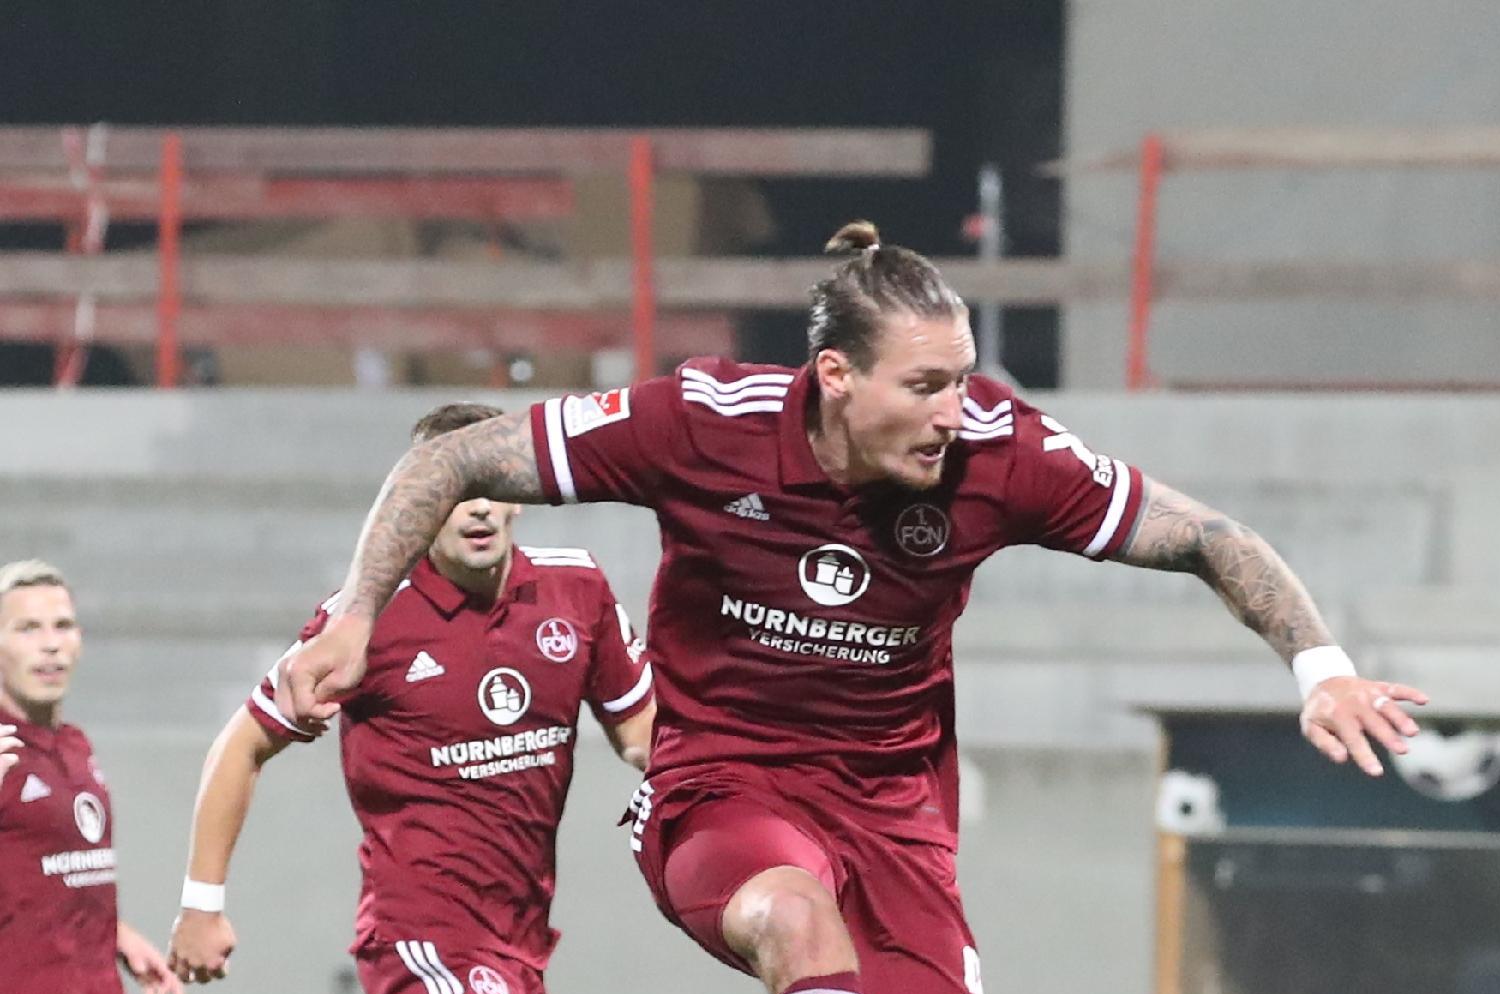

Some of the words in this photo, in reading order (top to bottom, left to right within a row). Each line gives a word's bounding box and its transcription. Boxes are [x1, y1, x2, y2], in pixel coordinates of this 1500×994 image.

[901, 526, 943, 545] FCN
[720, 594, 921, 648] NÜRNBERGER
[749, 627, 891, 664] VERSICHERUNG
[430, 725, 572, 768] NÜRNBERGER
[458, 751, 556, 780] VERSICHERUNG
